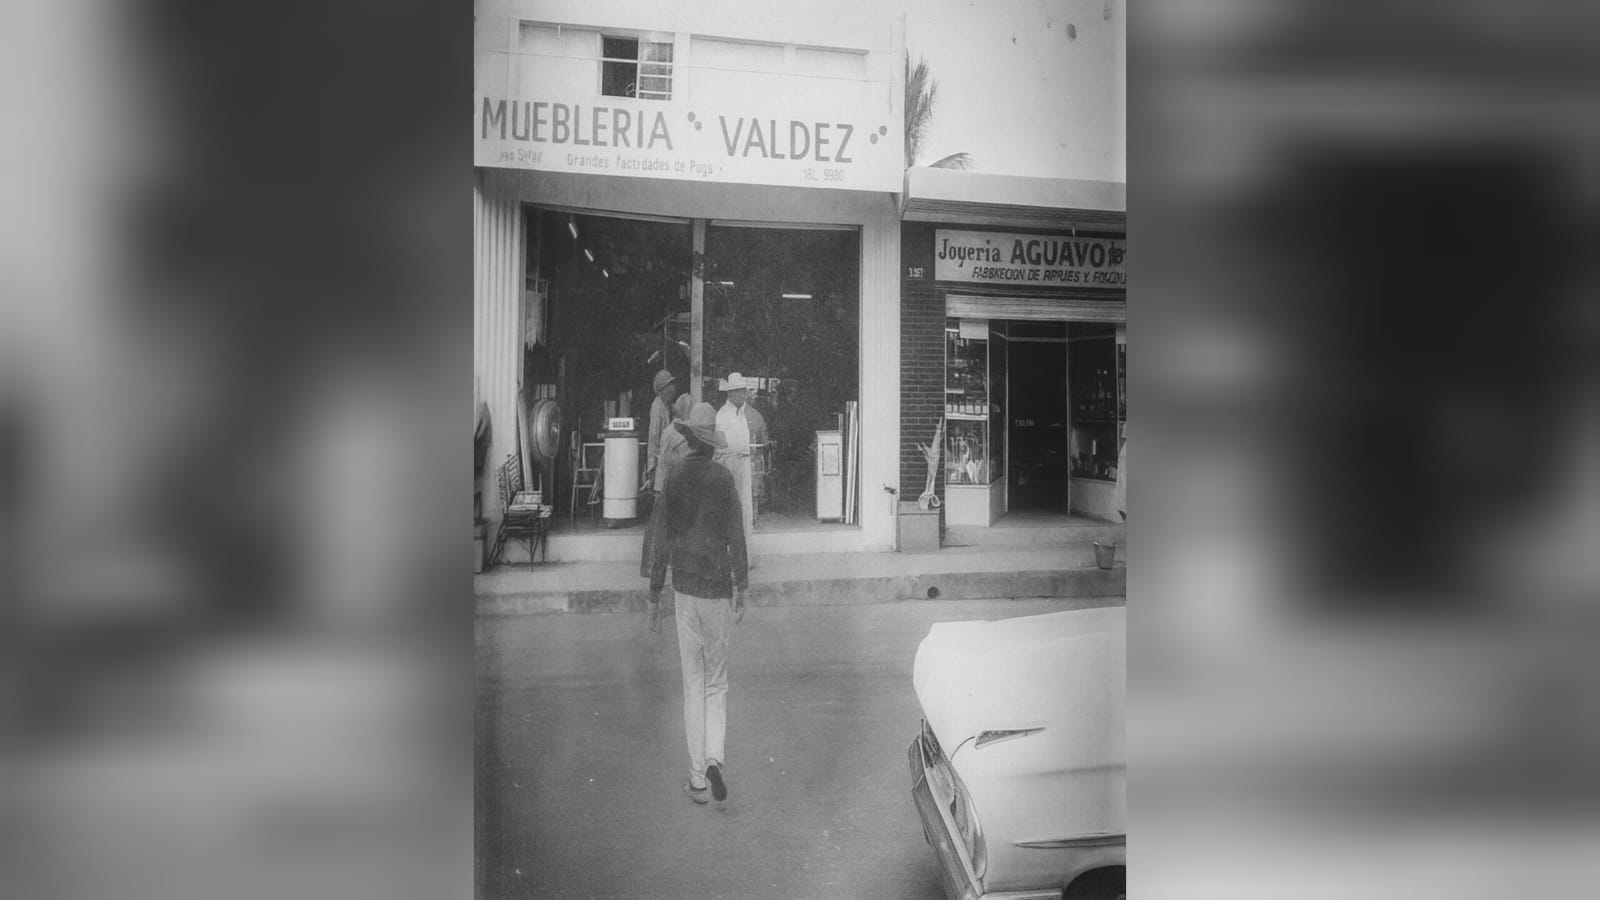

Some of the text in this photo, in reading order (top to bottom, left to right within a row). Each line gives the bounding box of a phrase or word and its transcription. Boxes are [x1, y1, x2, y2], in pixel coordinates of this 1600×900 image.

[482, 97, 853, 163] MUEBLERIA VALDEZ
[567, 153, 608, 168] Grandes
[674, 160, 685, 173] de
[938, 238, 1000, 268] Joyeria
[1010, 239, 1106, 268] AGUAVO
[1028, 268, 1040, 281] DE
[1083, 271, 1091, 283] Y
